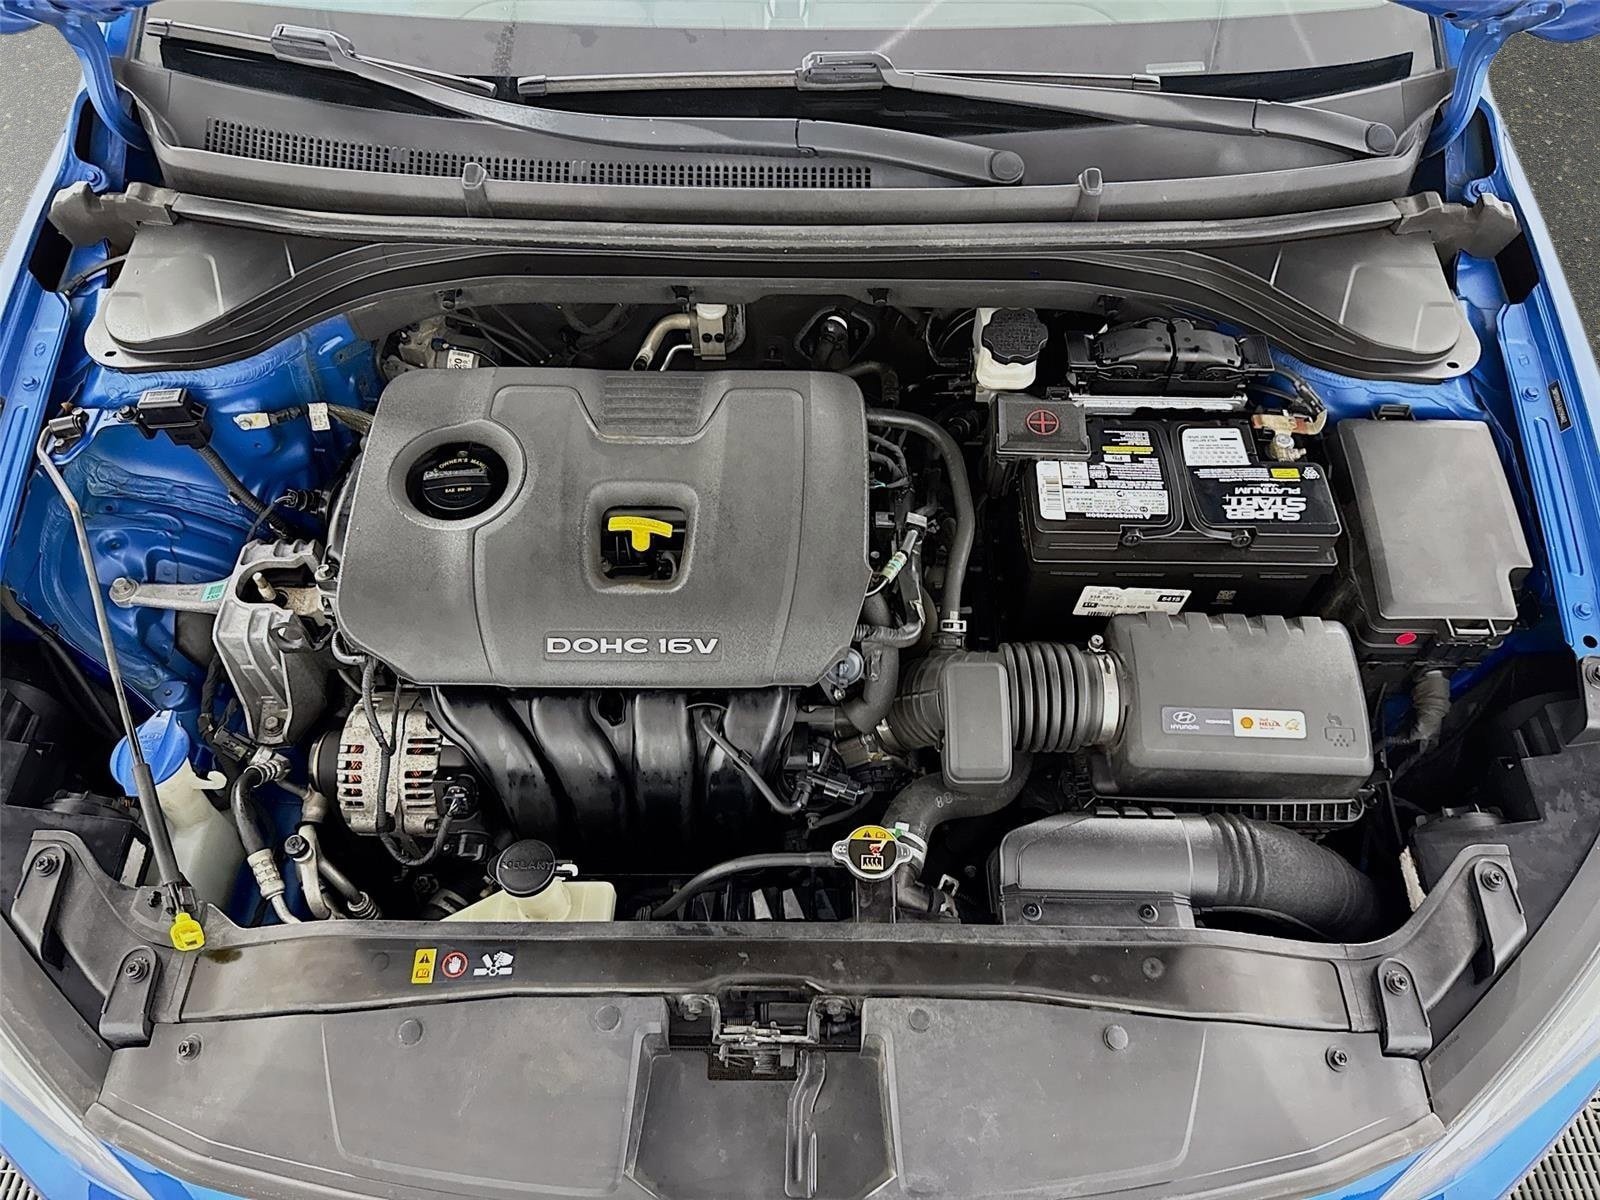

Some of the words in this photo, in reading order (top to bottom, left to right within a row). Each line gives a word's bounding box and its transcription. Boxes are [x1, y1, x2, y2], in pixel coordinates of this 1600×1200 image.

[1235, 487, 1301, 495] PLATINUM
[1222, 496, 1307, 512] START
[1226, 507, 1301, 521] SUPER
[546, 637, 649, 654] DOHC
[658, 638, 719, 654] 16V
